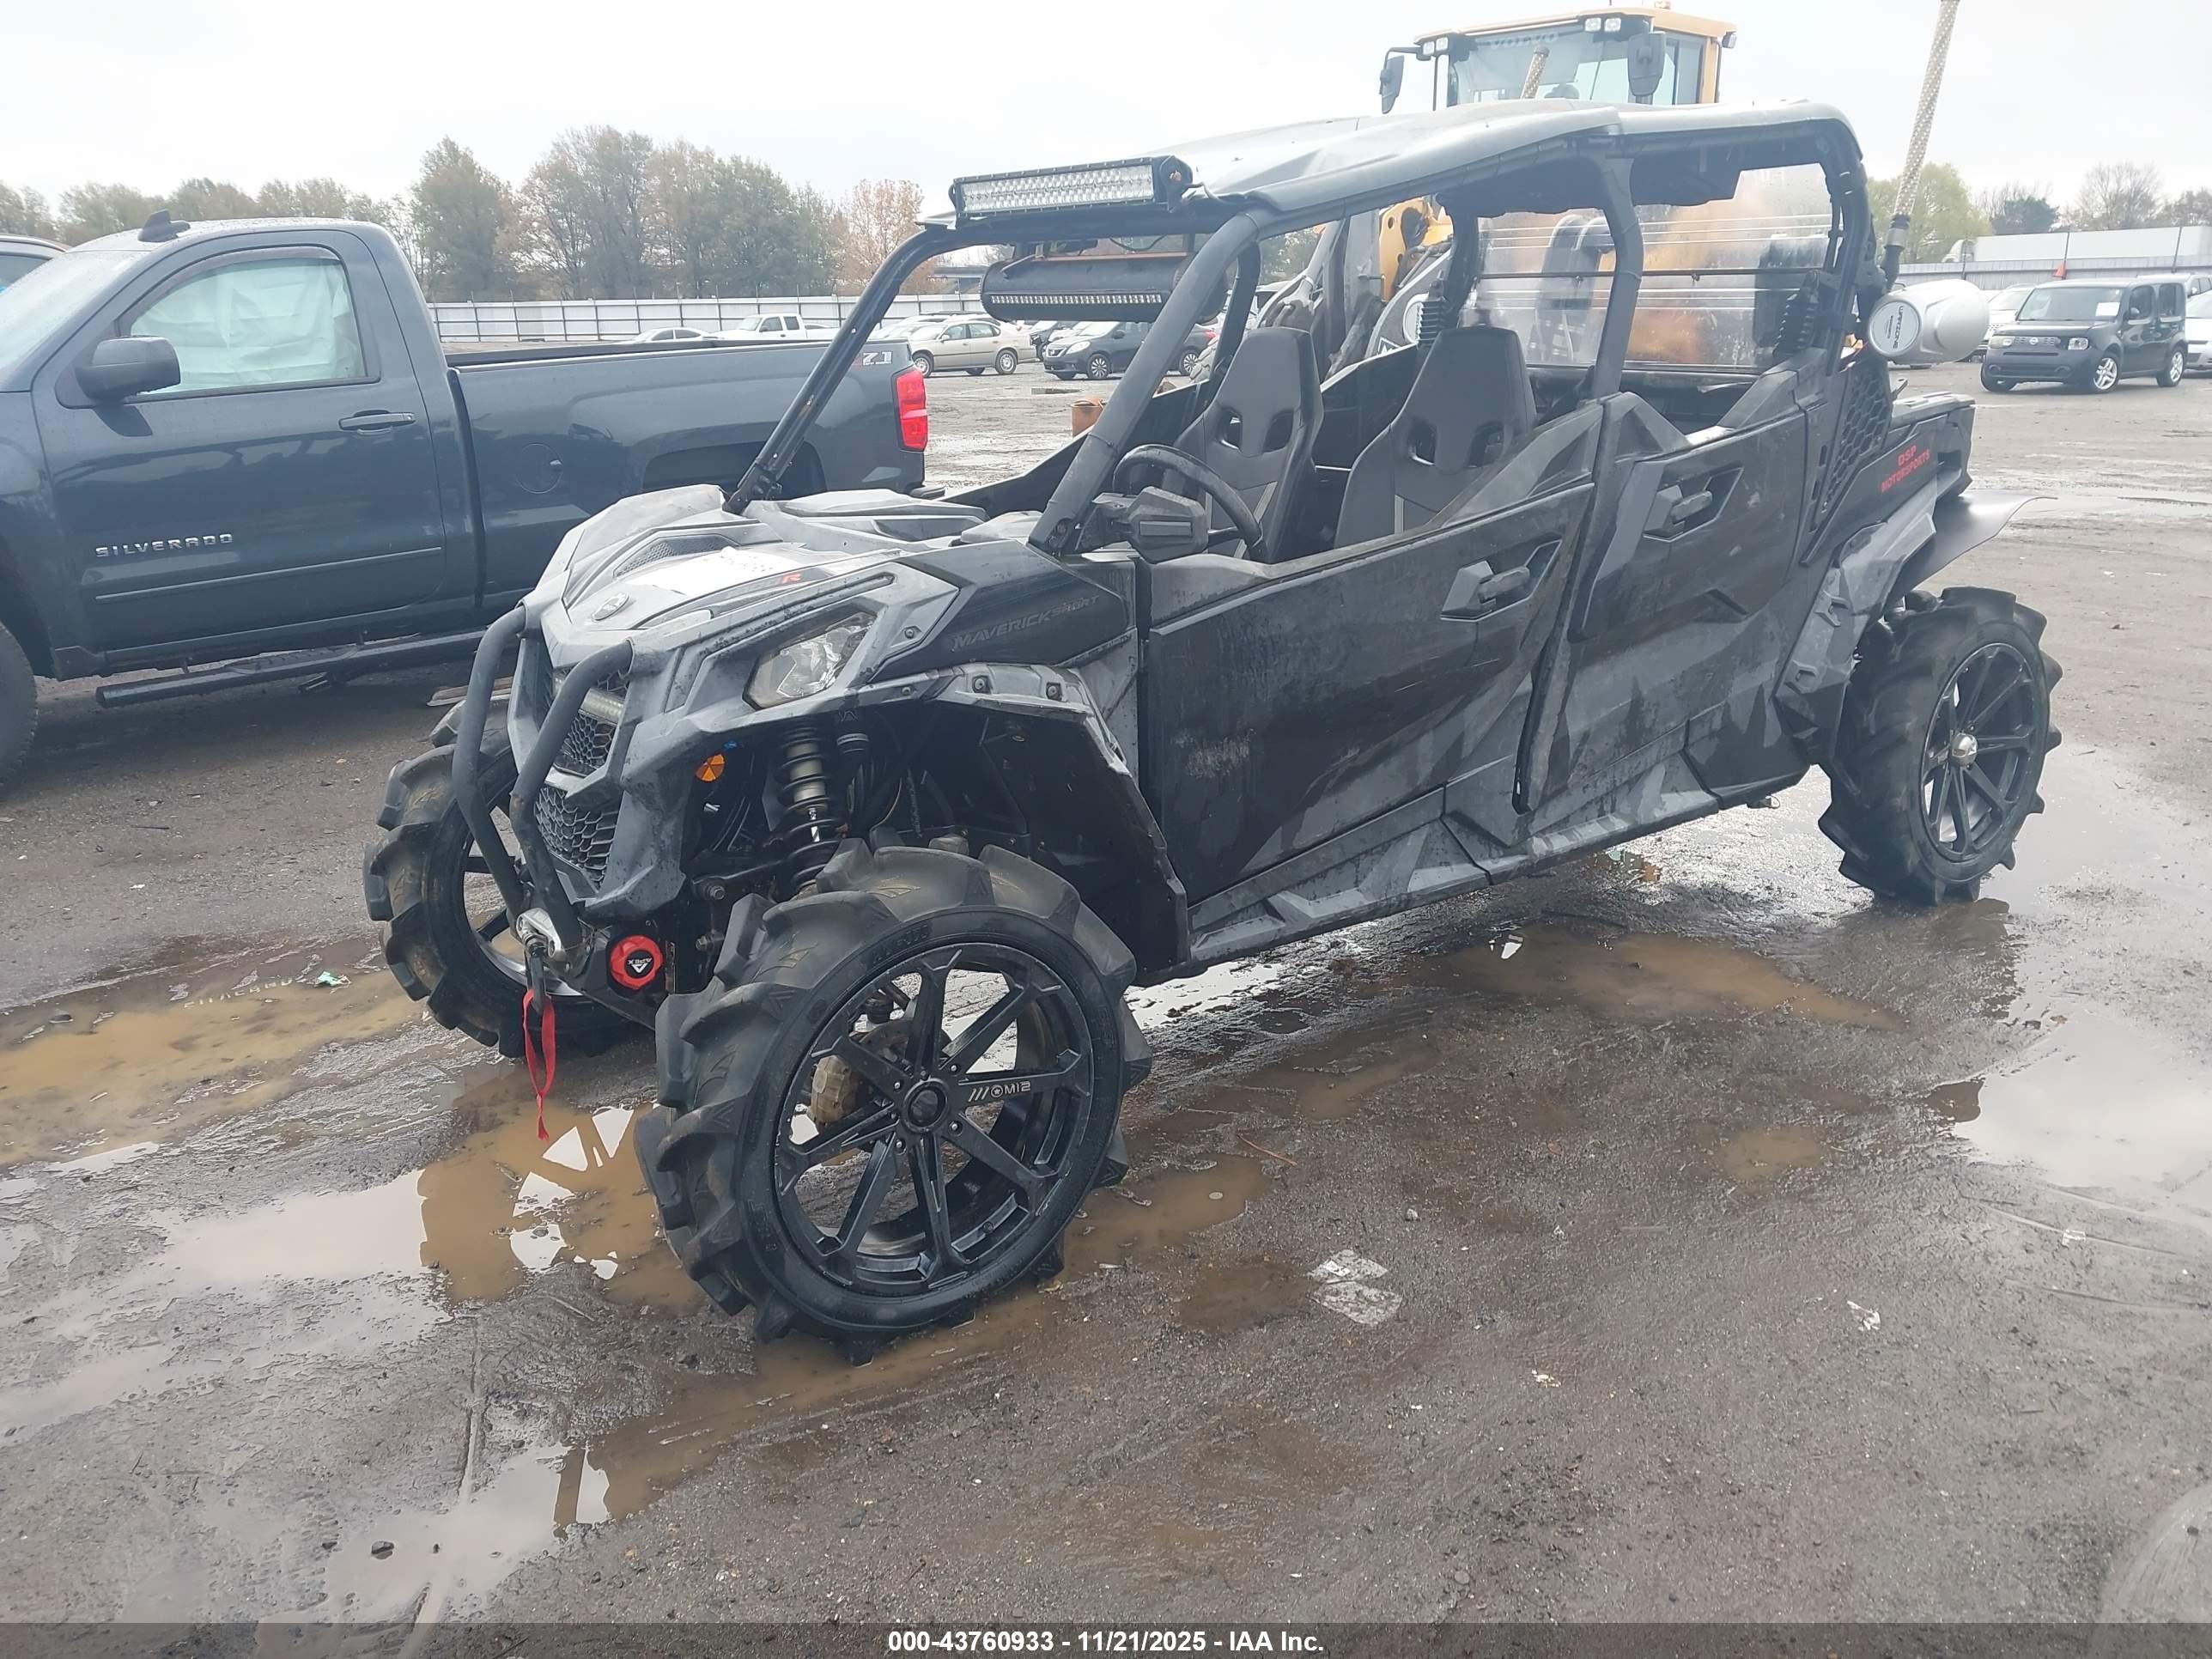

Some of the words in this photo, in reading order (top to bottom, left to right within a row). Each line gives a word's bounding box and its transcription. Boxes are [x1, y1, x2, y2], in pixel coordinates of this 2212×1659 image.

[1487, 32, 1559, 50] VOLVO
[1881, 448, 1931, 493] MOTORSPORTS
[94, 532, 234, 558] SILVERADO
